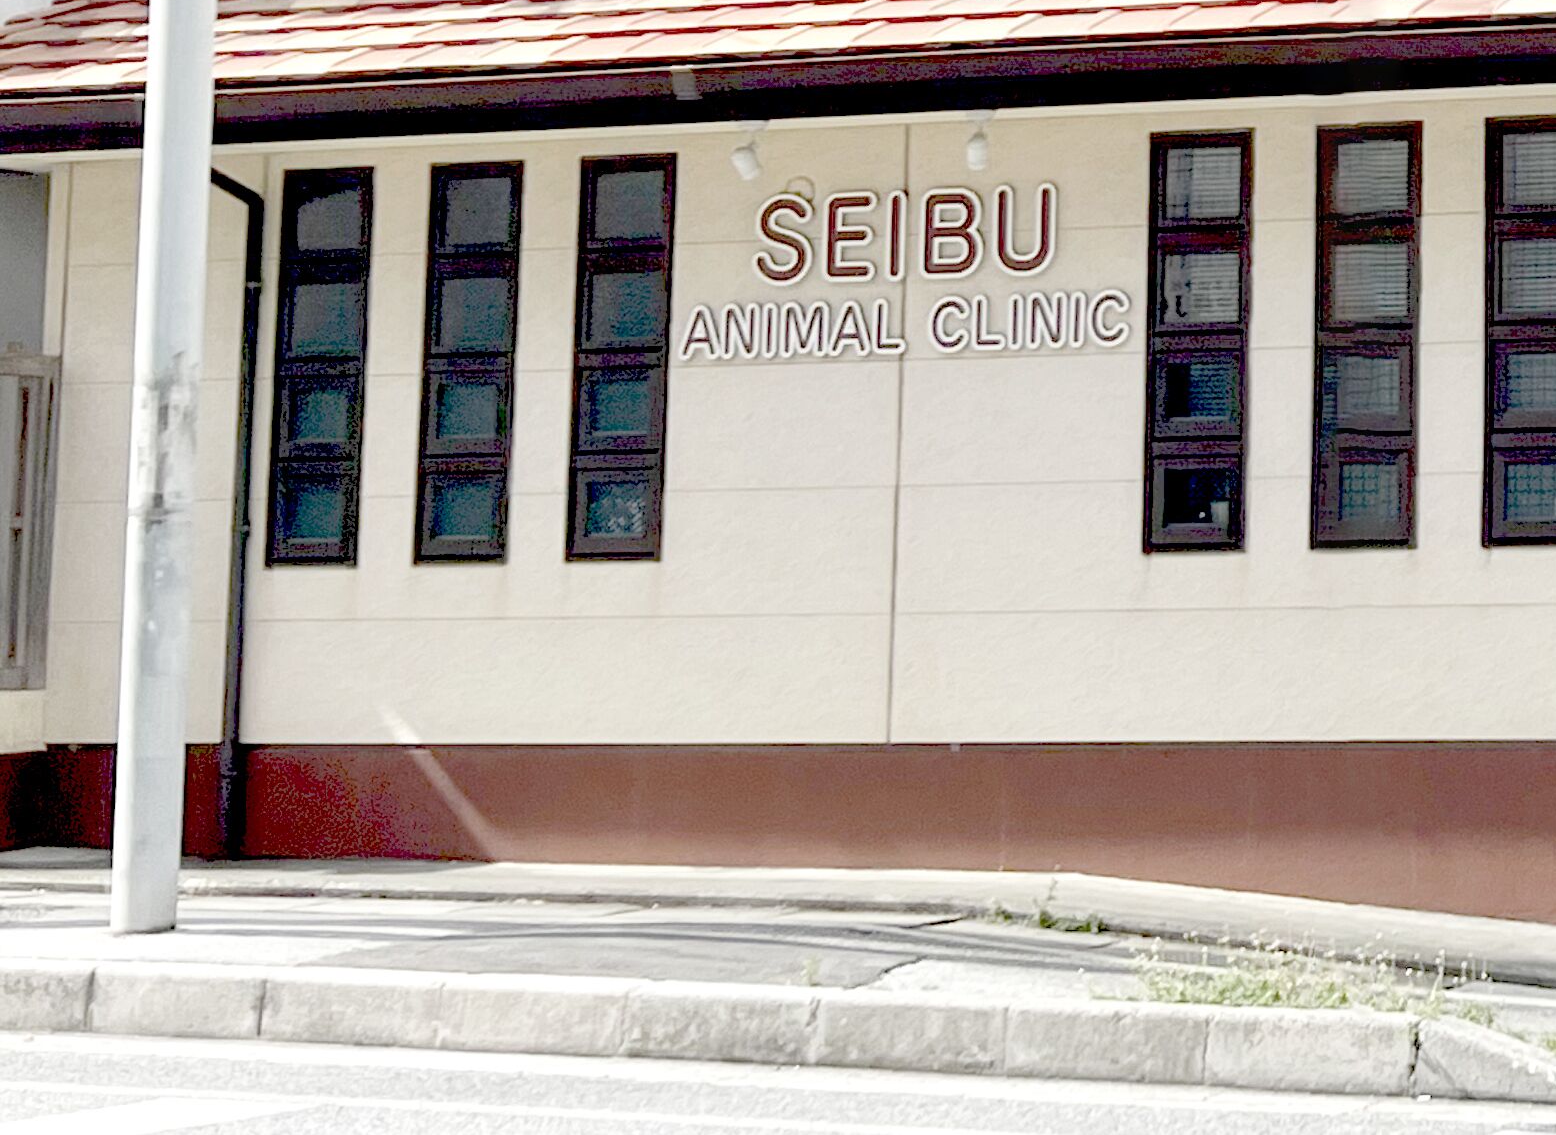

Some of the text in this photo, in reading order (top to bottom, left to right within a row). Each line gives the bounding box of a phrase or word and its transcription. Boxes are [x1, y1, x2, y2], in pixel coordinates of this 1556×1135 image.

[753, 182, 1058, 286] SEIBU
[679, 289, 1130, 361] ANIMAL CLINIC
